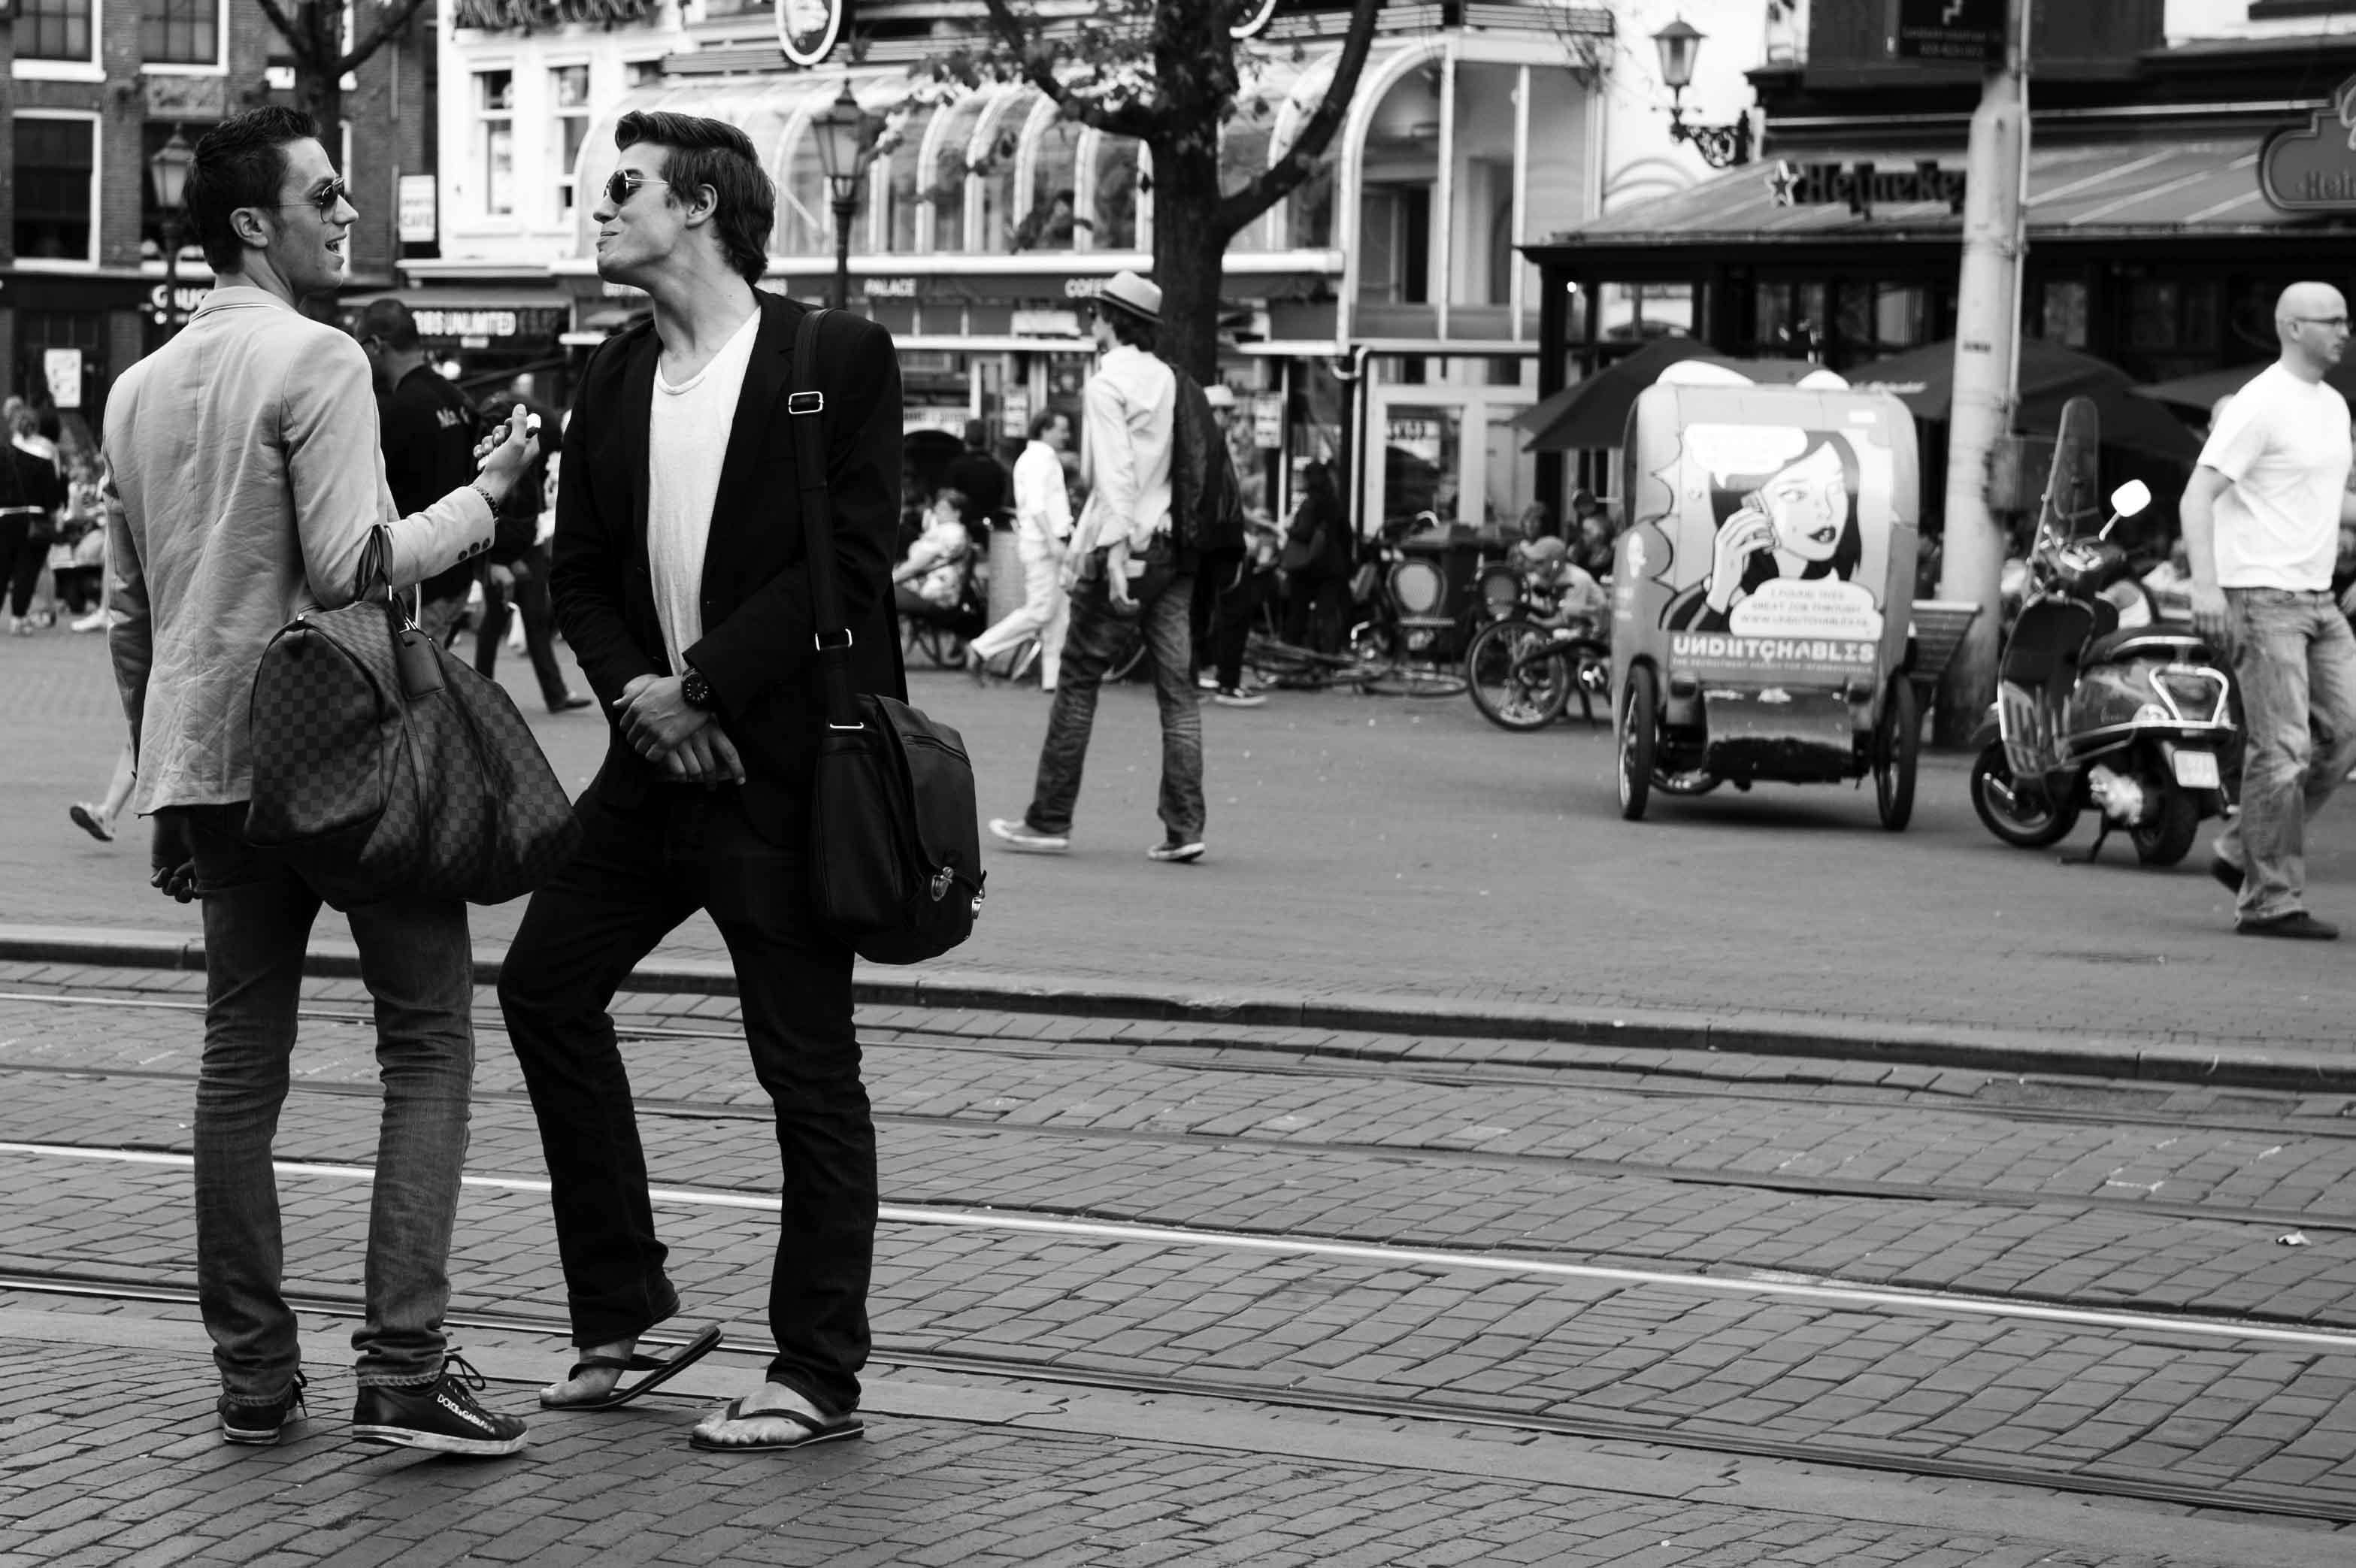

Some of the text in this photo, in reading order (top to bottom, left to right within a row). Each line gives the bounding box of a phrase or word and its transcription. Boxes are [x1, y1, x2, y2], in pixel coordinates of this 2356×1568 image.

[1803, 164, 1967, 207] Heineke
[864, 277, 916, 297] PALACE
[445, 310, 516, 337] UNLIMITED
[1673, 635, 1875, 663] UNDUTCHABLES
